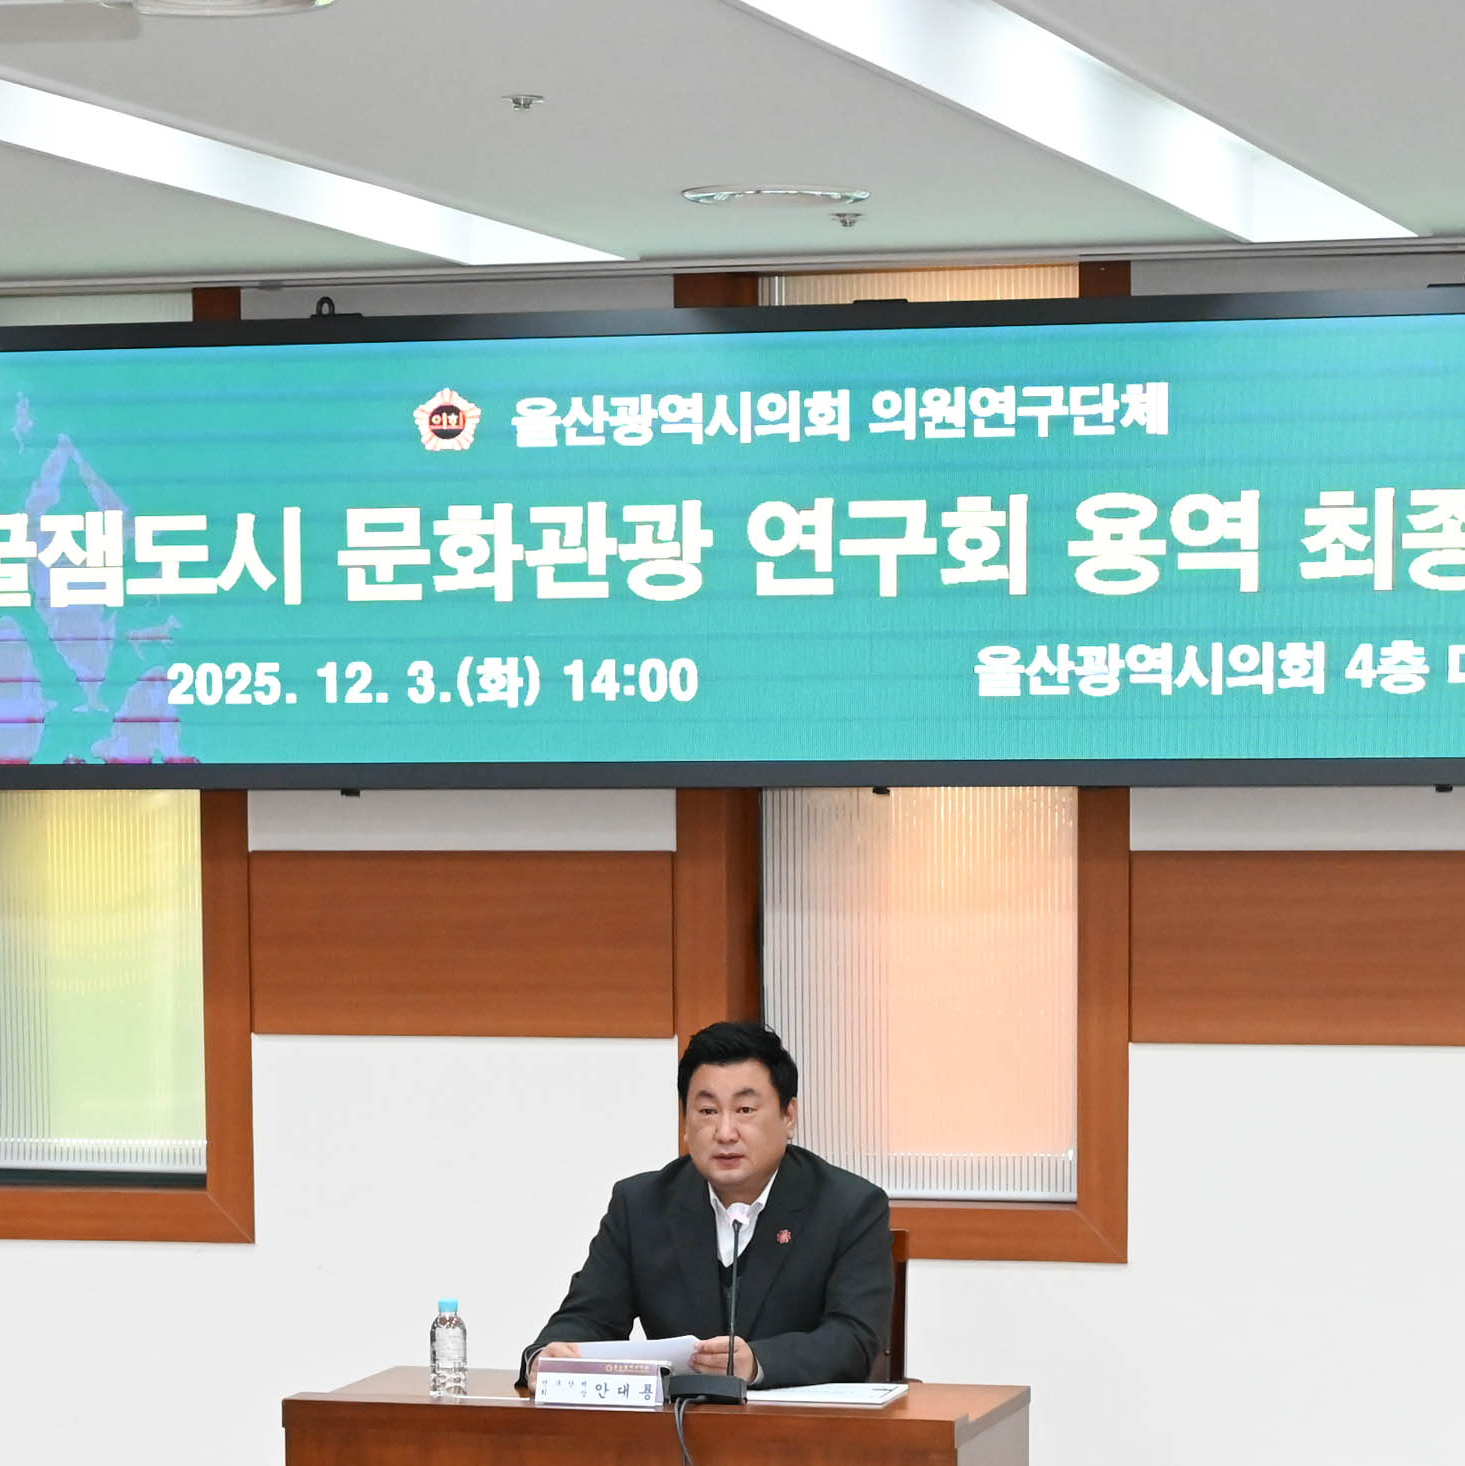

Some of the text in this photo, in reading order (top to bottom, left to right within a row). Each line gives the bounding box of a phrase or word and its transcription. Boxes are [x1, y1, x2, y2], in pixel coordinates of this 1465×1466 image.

[511, 382, 1169, 447] 울산광역시의회 의원연구단체
[336, 499, 713, 602] 문화관광
[747, 494, 1028, 598] 연구회
[1067, 490, 1260, 595] 용역
[166, 656, 699, 709] 2025. 12. 3.(화) 14:00
[973, 641, 1325, 697] 울산광역시의회
[1345, 640, 1430, 695] 4층
